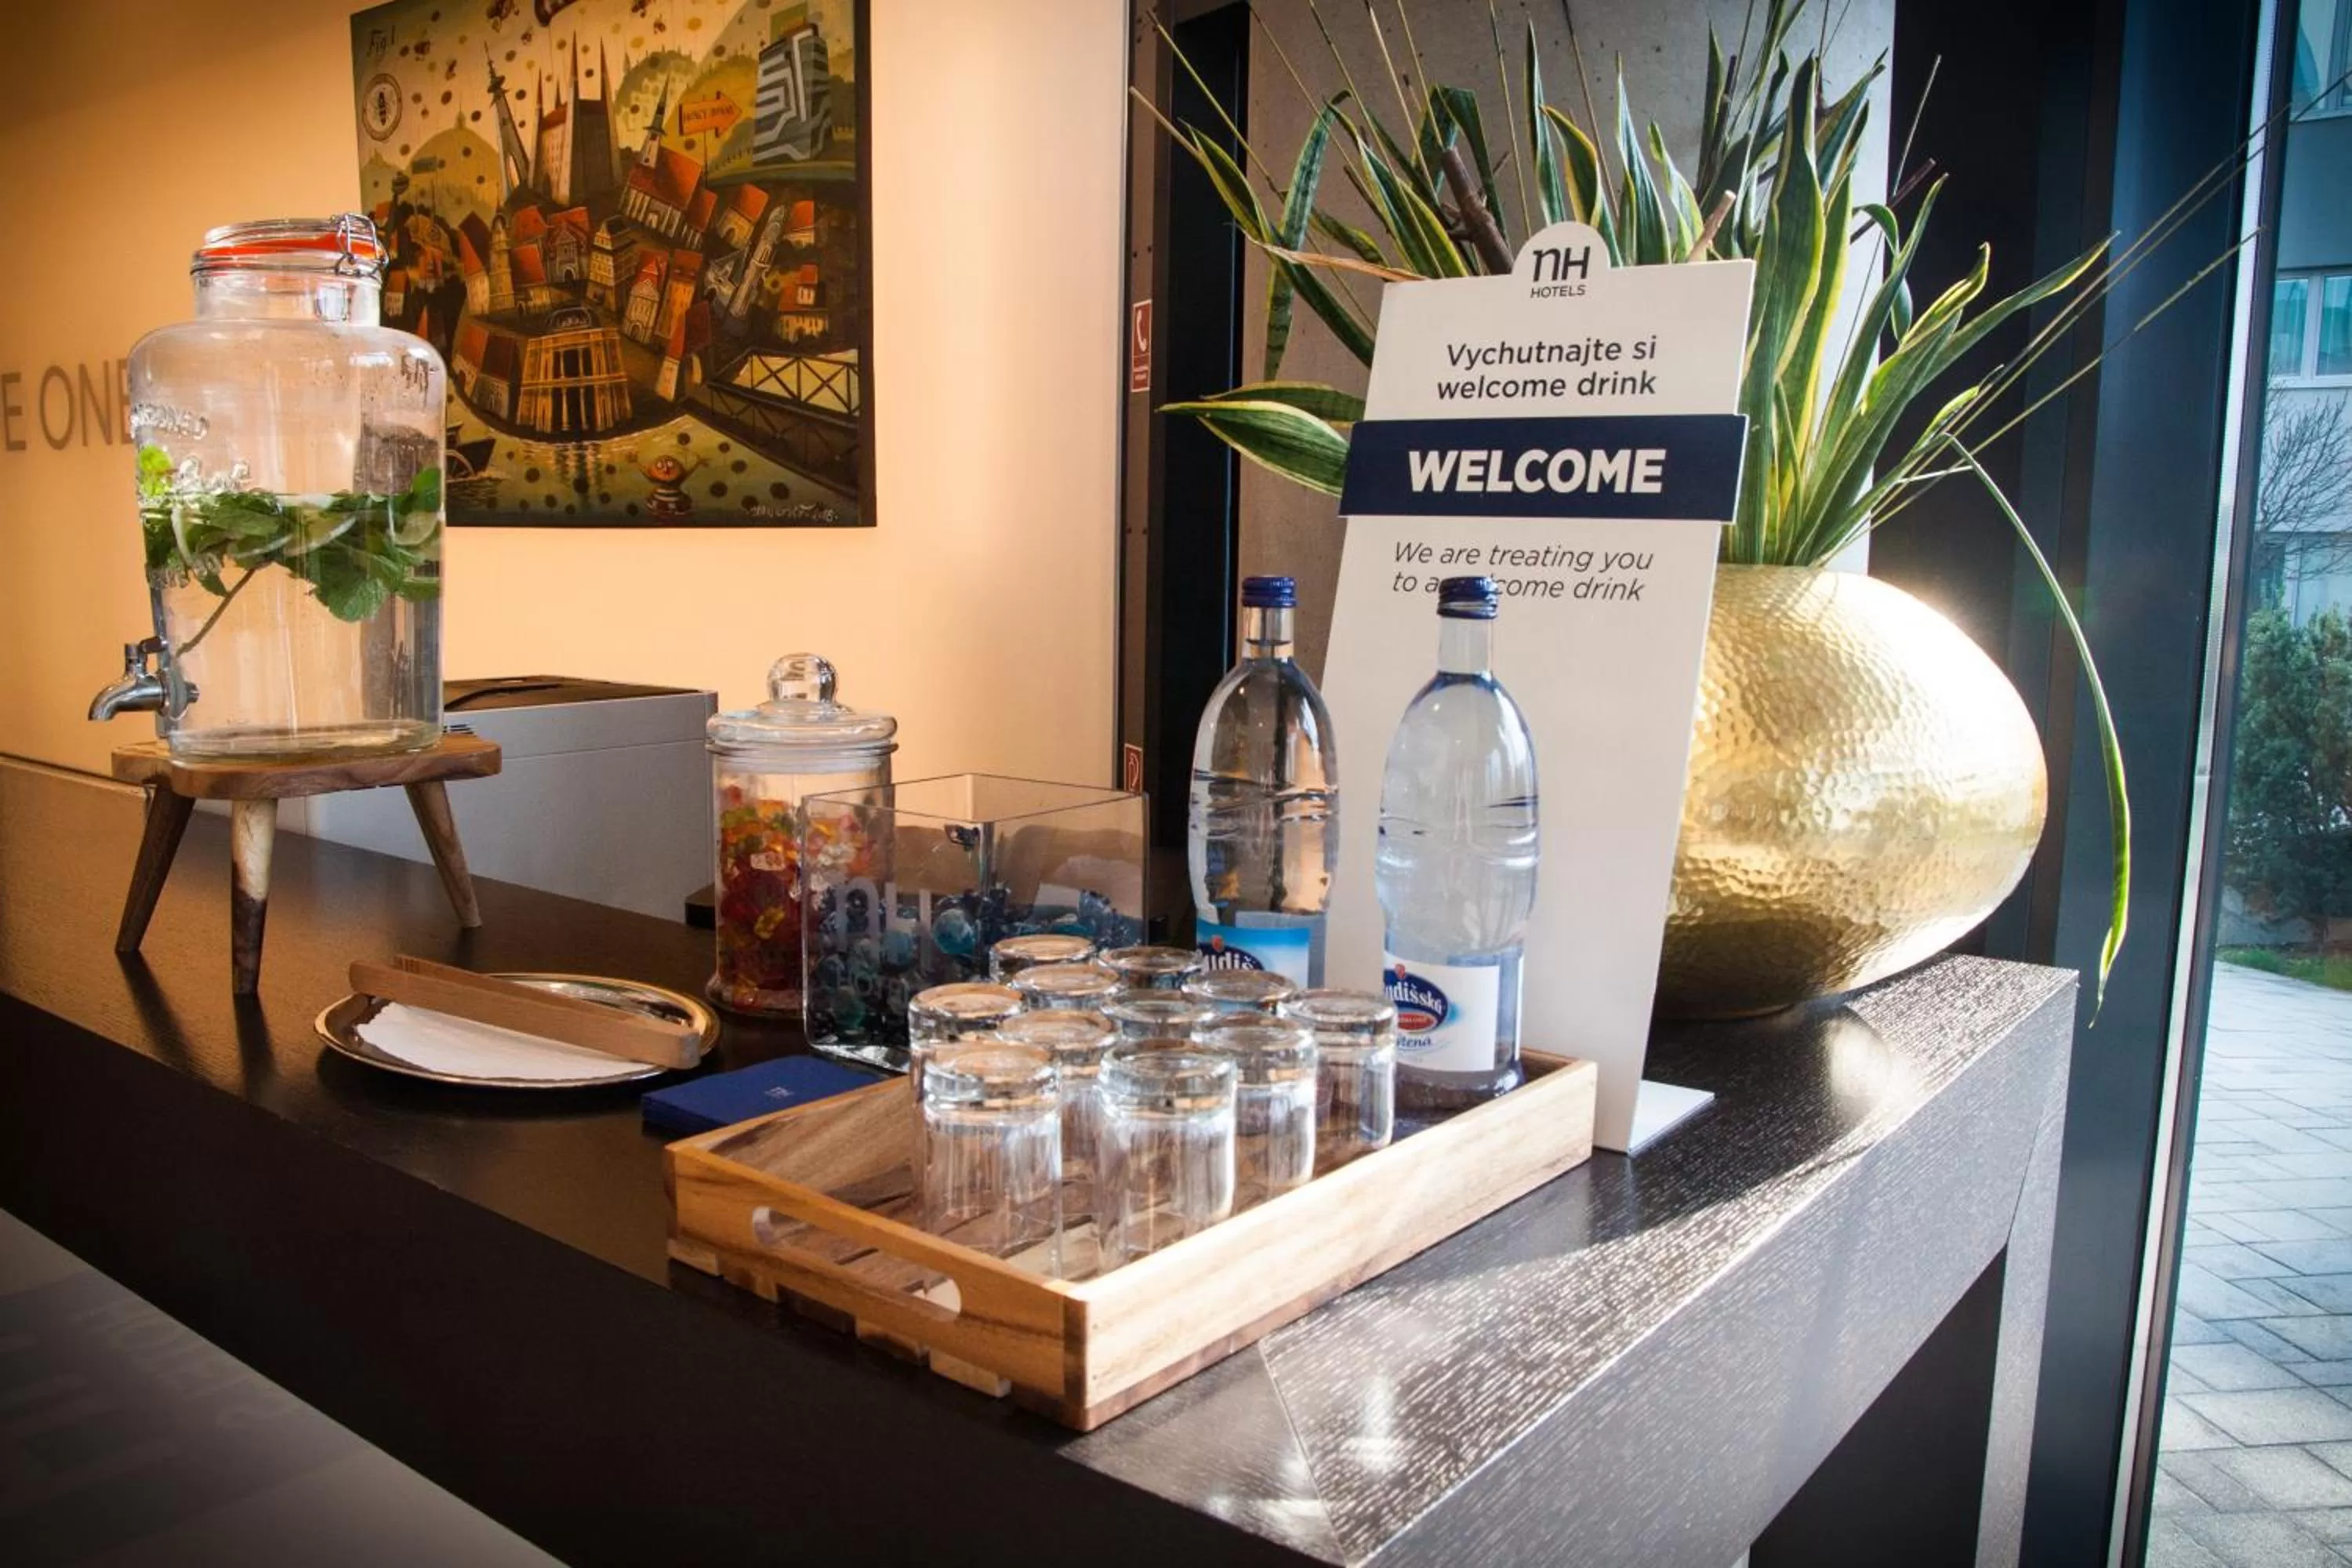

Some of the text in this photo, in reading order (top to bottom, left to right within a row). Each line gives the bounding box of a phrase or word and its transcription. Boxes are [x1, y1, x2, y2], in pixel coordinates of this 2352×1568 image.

[1530, 284, 1587, 299] HOTELS
[1446, 335, 1657, 371] Vychutnajte si
[1437, 370, 1657, 400] welcome drink
[1408, 448, 1667, 494] WELCOME
[1395, 542, 1654, 573] We are treating you
[1392, 570, 1417, 593] to
[1425, 578, 1440, 593] a
[1573, 576, 1647, 601] drink
